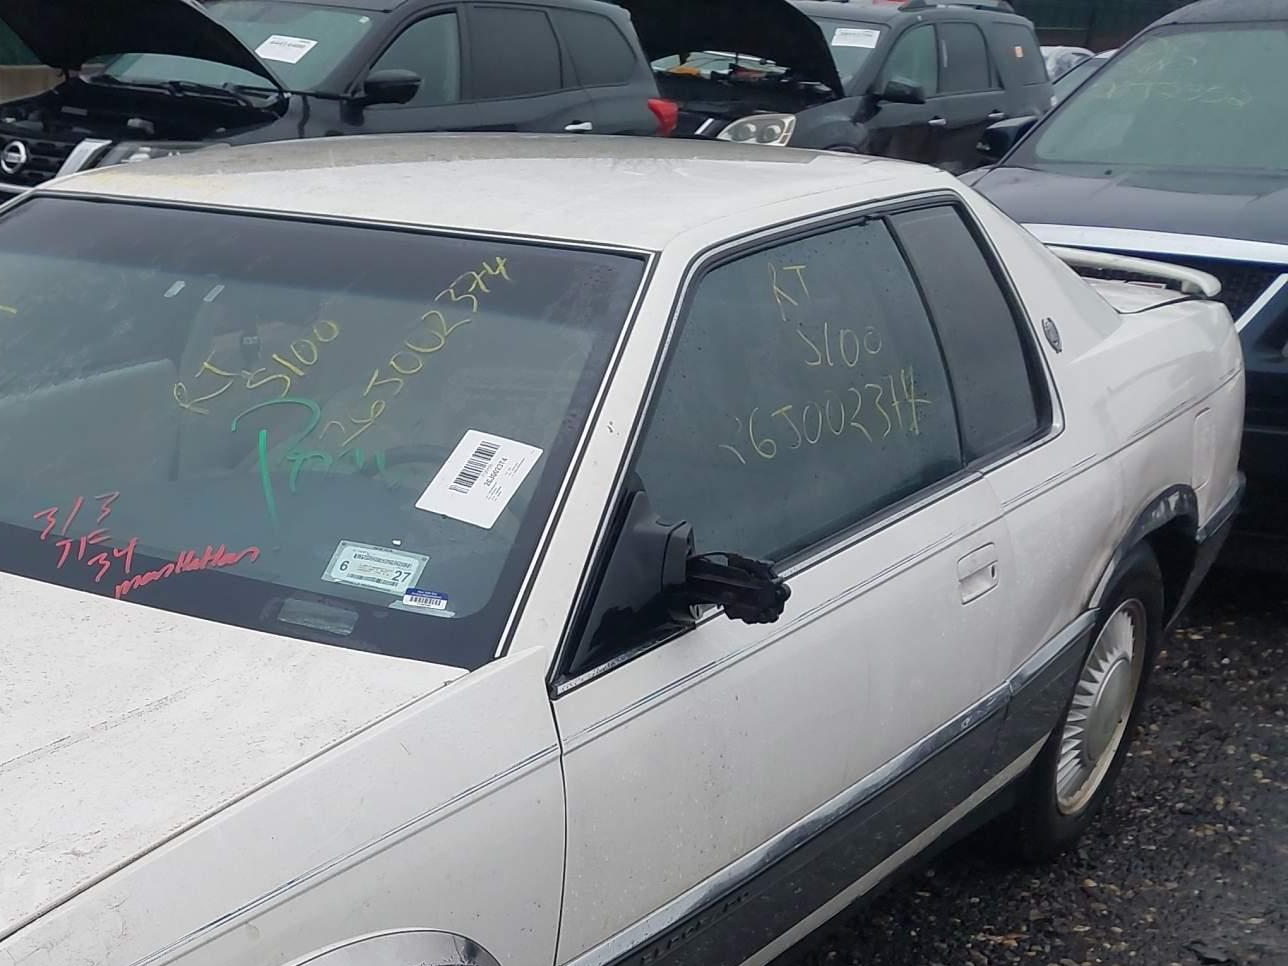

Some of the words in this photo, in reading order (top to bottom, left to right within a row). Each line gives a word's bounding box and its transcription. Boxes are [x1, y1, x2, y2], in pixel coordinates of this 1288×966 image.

[768, 262, 810, 322] RT
[339, 560, 350, 572] 6
[392, 570, 411, 583] 27
